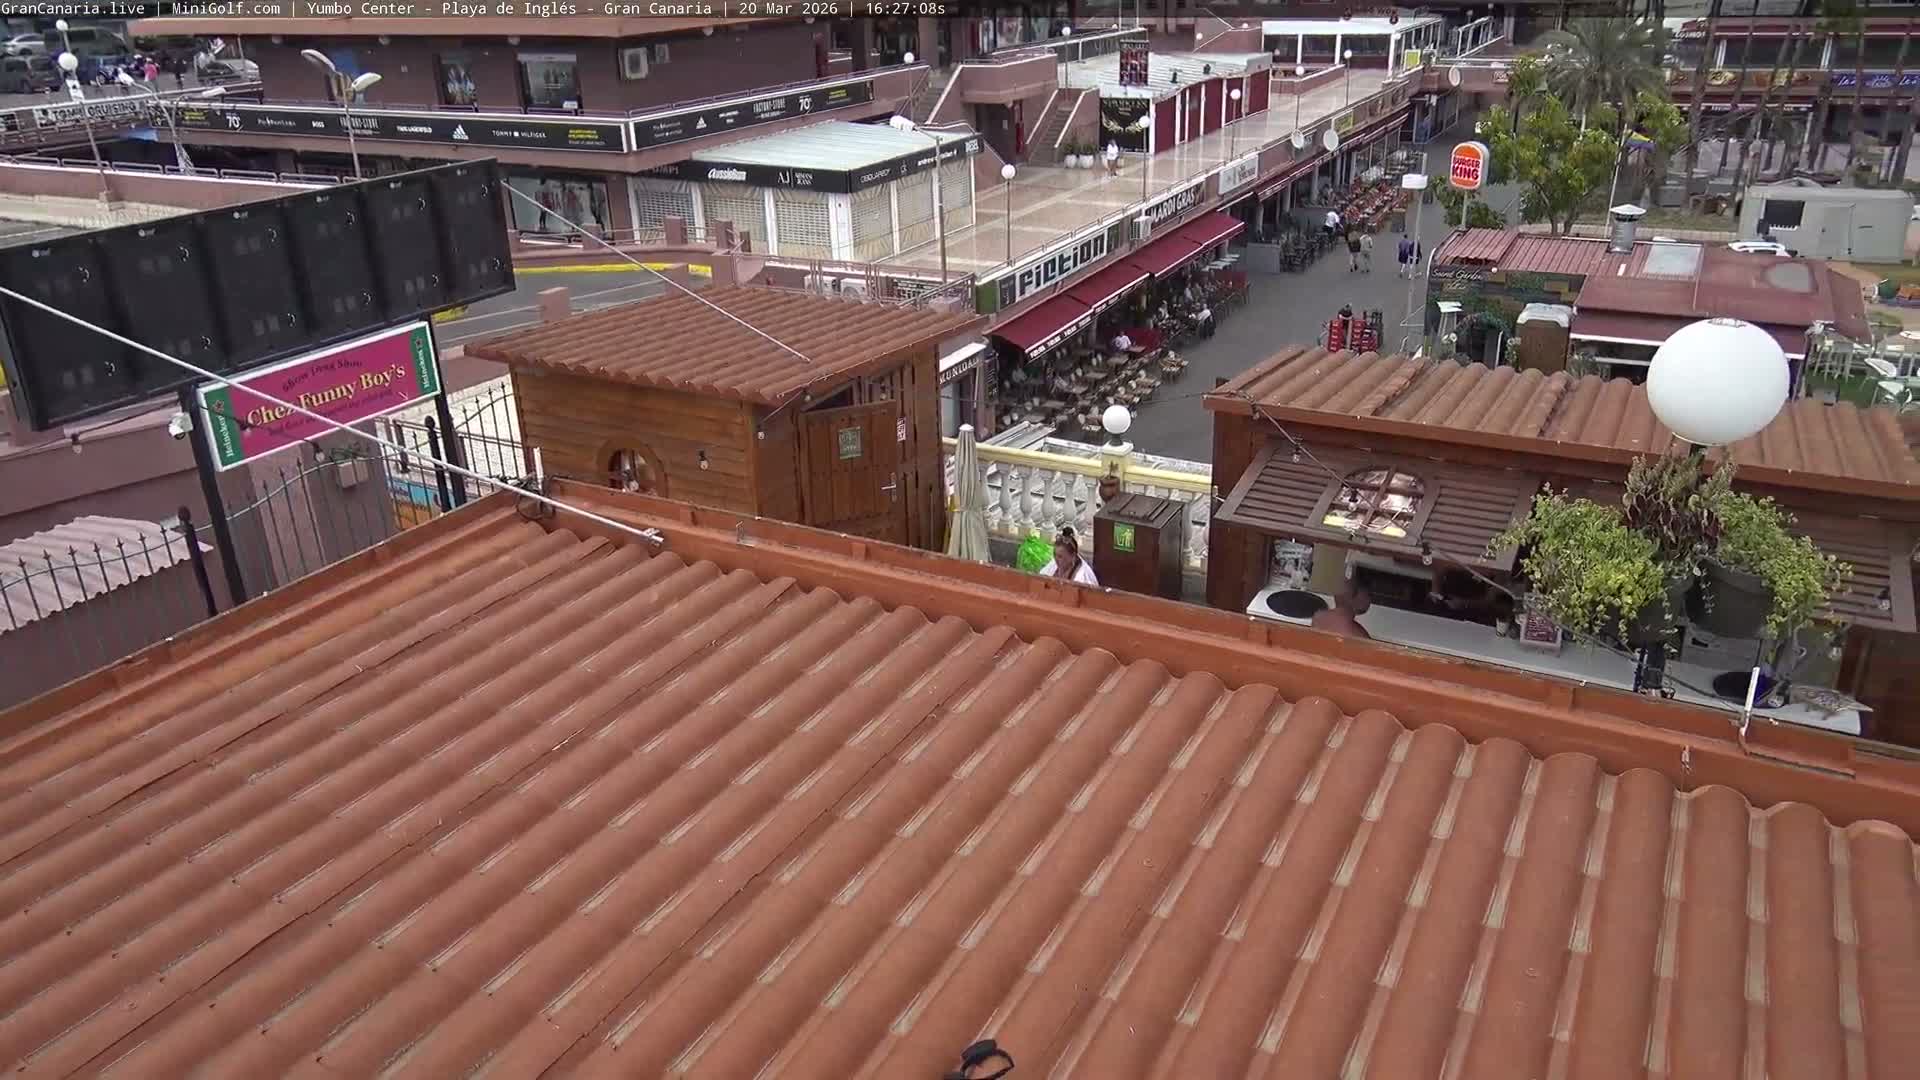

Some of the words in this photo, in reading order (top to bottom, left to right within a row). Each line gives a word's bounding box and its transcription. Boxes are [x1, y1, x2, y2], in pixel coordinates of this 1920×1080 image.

[1452, 166, 1479, 180] KING
[1453, 156, 1480, 169] BURGER
[1150, 198, 1176, 222] MARDI
[246, 403, 297, 426] Chez
[298, 381, 358, 410] Funny
[360, 363, 406, 390] Boy's
[216, 414, 235, 458] Heineken
